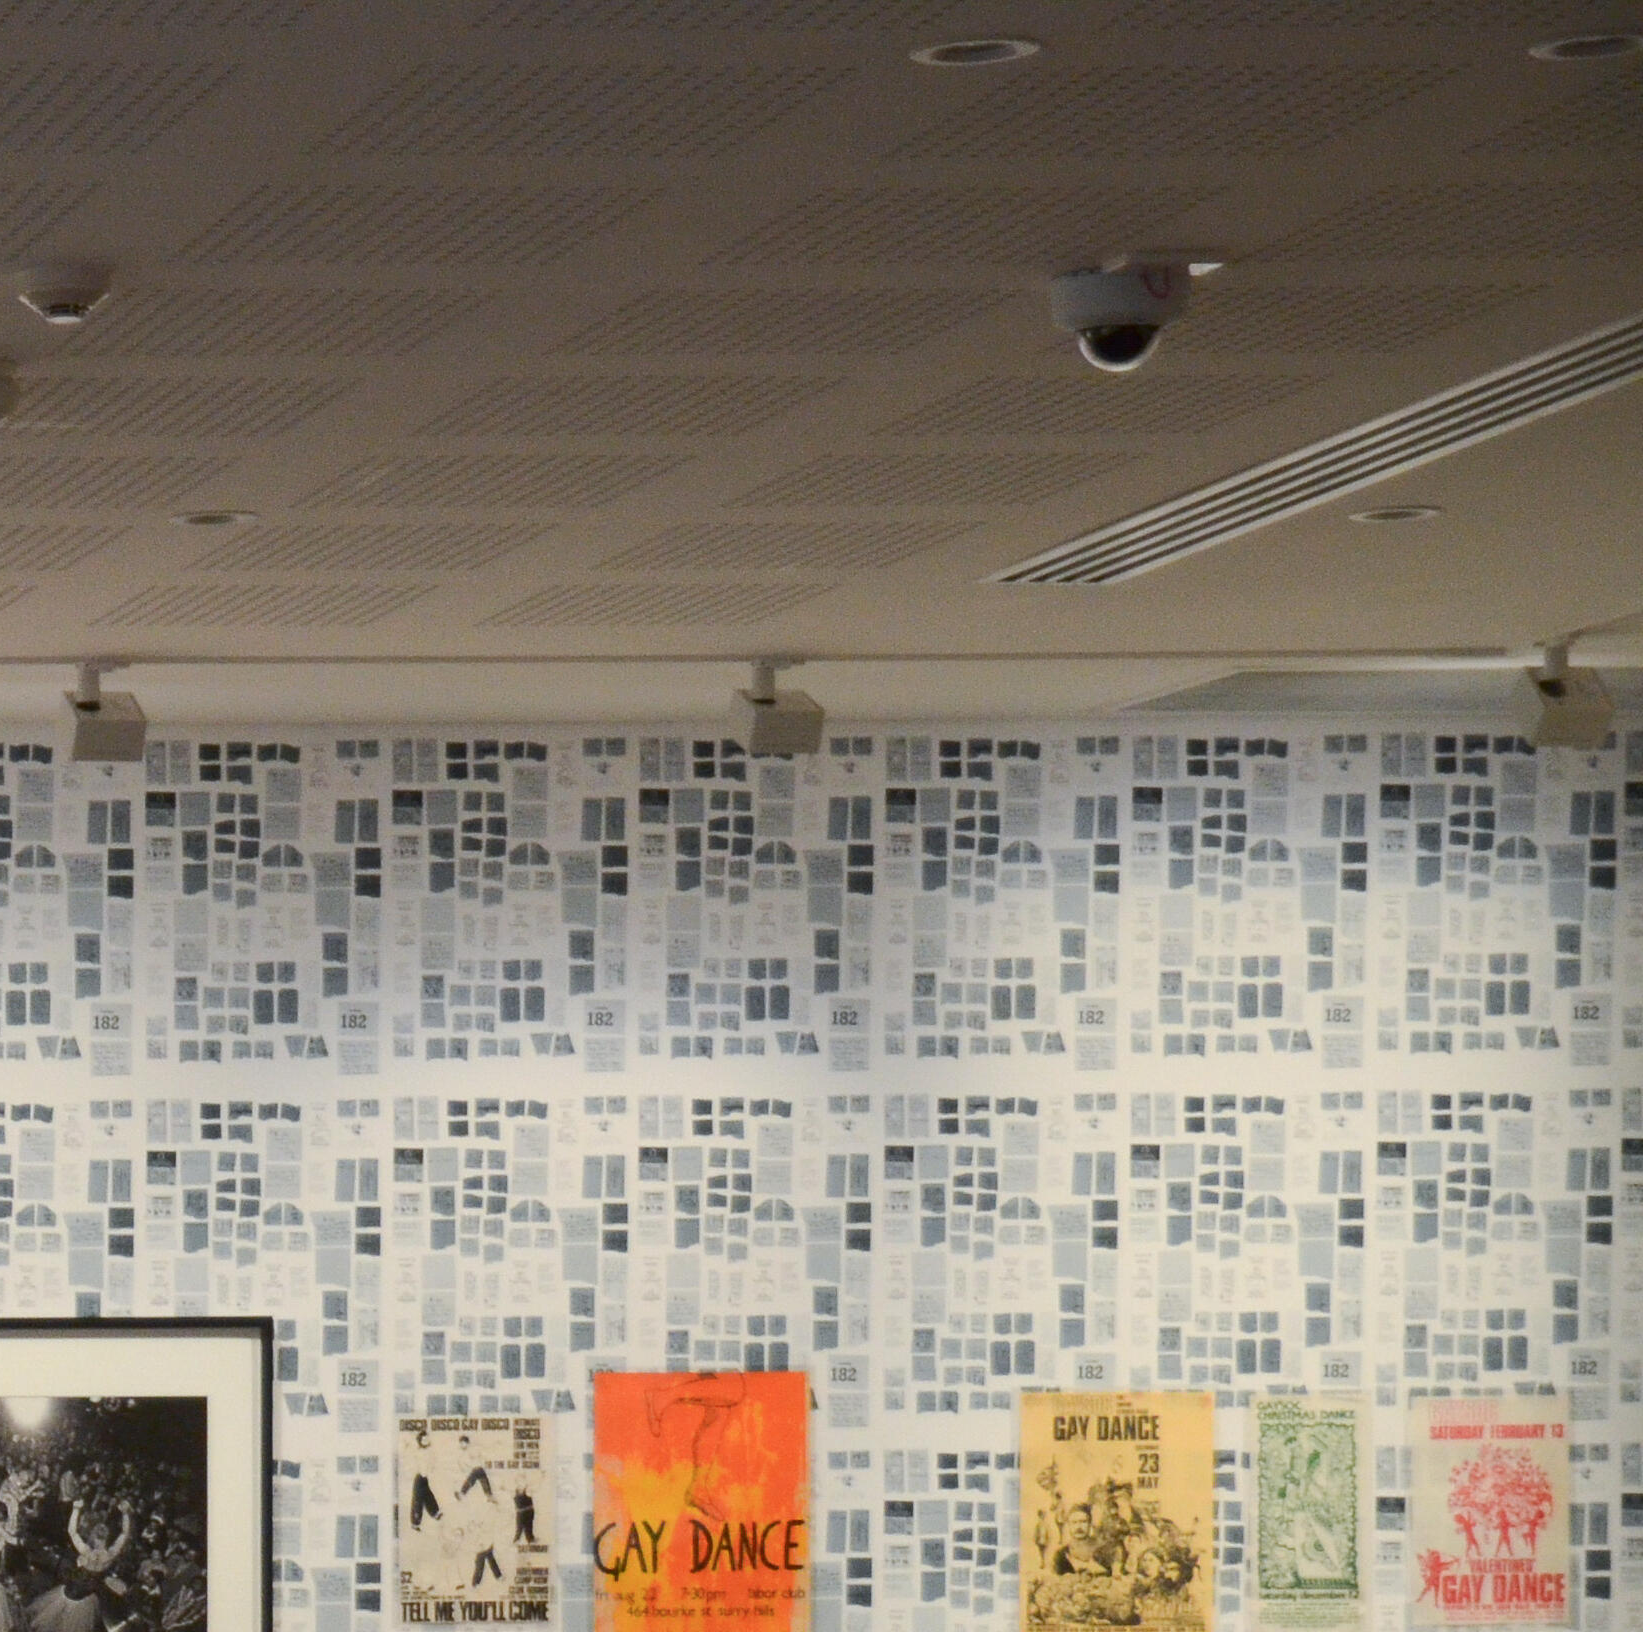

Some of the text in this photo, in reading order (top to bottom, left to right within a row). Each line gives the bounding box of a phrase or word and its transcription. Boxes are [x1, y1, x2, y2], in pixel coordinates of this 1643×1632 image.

[586, 1011, 614, 1027] 182
[831, 1010, 859, 1026] 182
[1077, 1009, 1105, 1025] 182
[1324, 1007, 1352, 1023] 182
[1573, 1005, 1601, 1021] 182
[93, 1015, 121, 1031] 182
[340, 1014, 368, 1030] 182
[830, 1367, 858, 1383] 182
[1077, 1365, 1105, 1380] 182
[1322, 1364, 1350, 1379] 182
[1570, 1360, 1598, 1376] 182
[340, 1372, 368, 1388] 182
[1320, 1409, 1355, 1420] DANCE
[1053, 1415, 1160, 1441] GAY DANCE
[1138, 1453, 1160, 1474] 23
[1137, 1476, 1159, 1489] MAY
[594, 1519, 805, 1581] GAY DANCE
[1442, 1572, 1565, 1604] GAY DANCE
[401, 1600, 549, 1622] TELL ME YOU'LL COME
